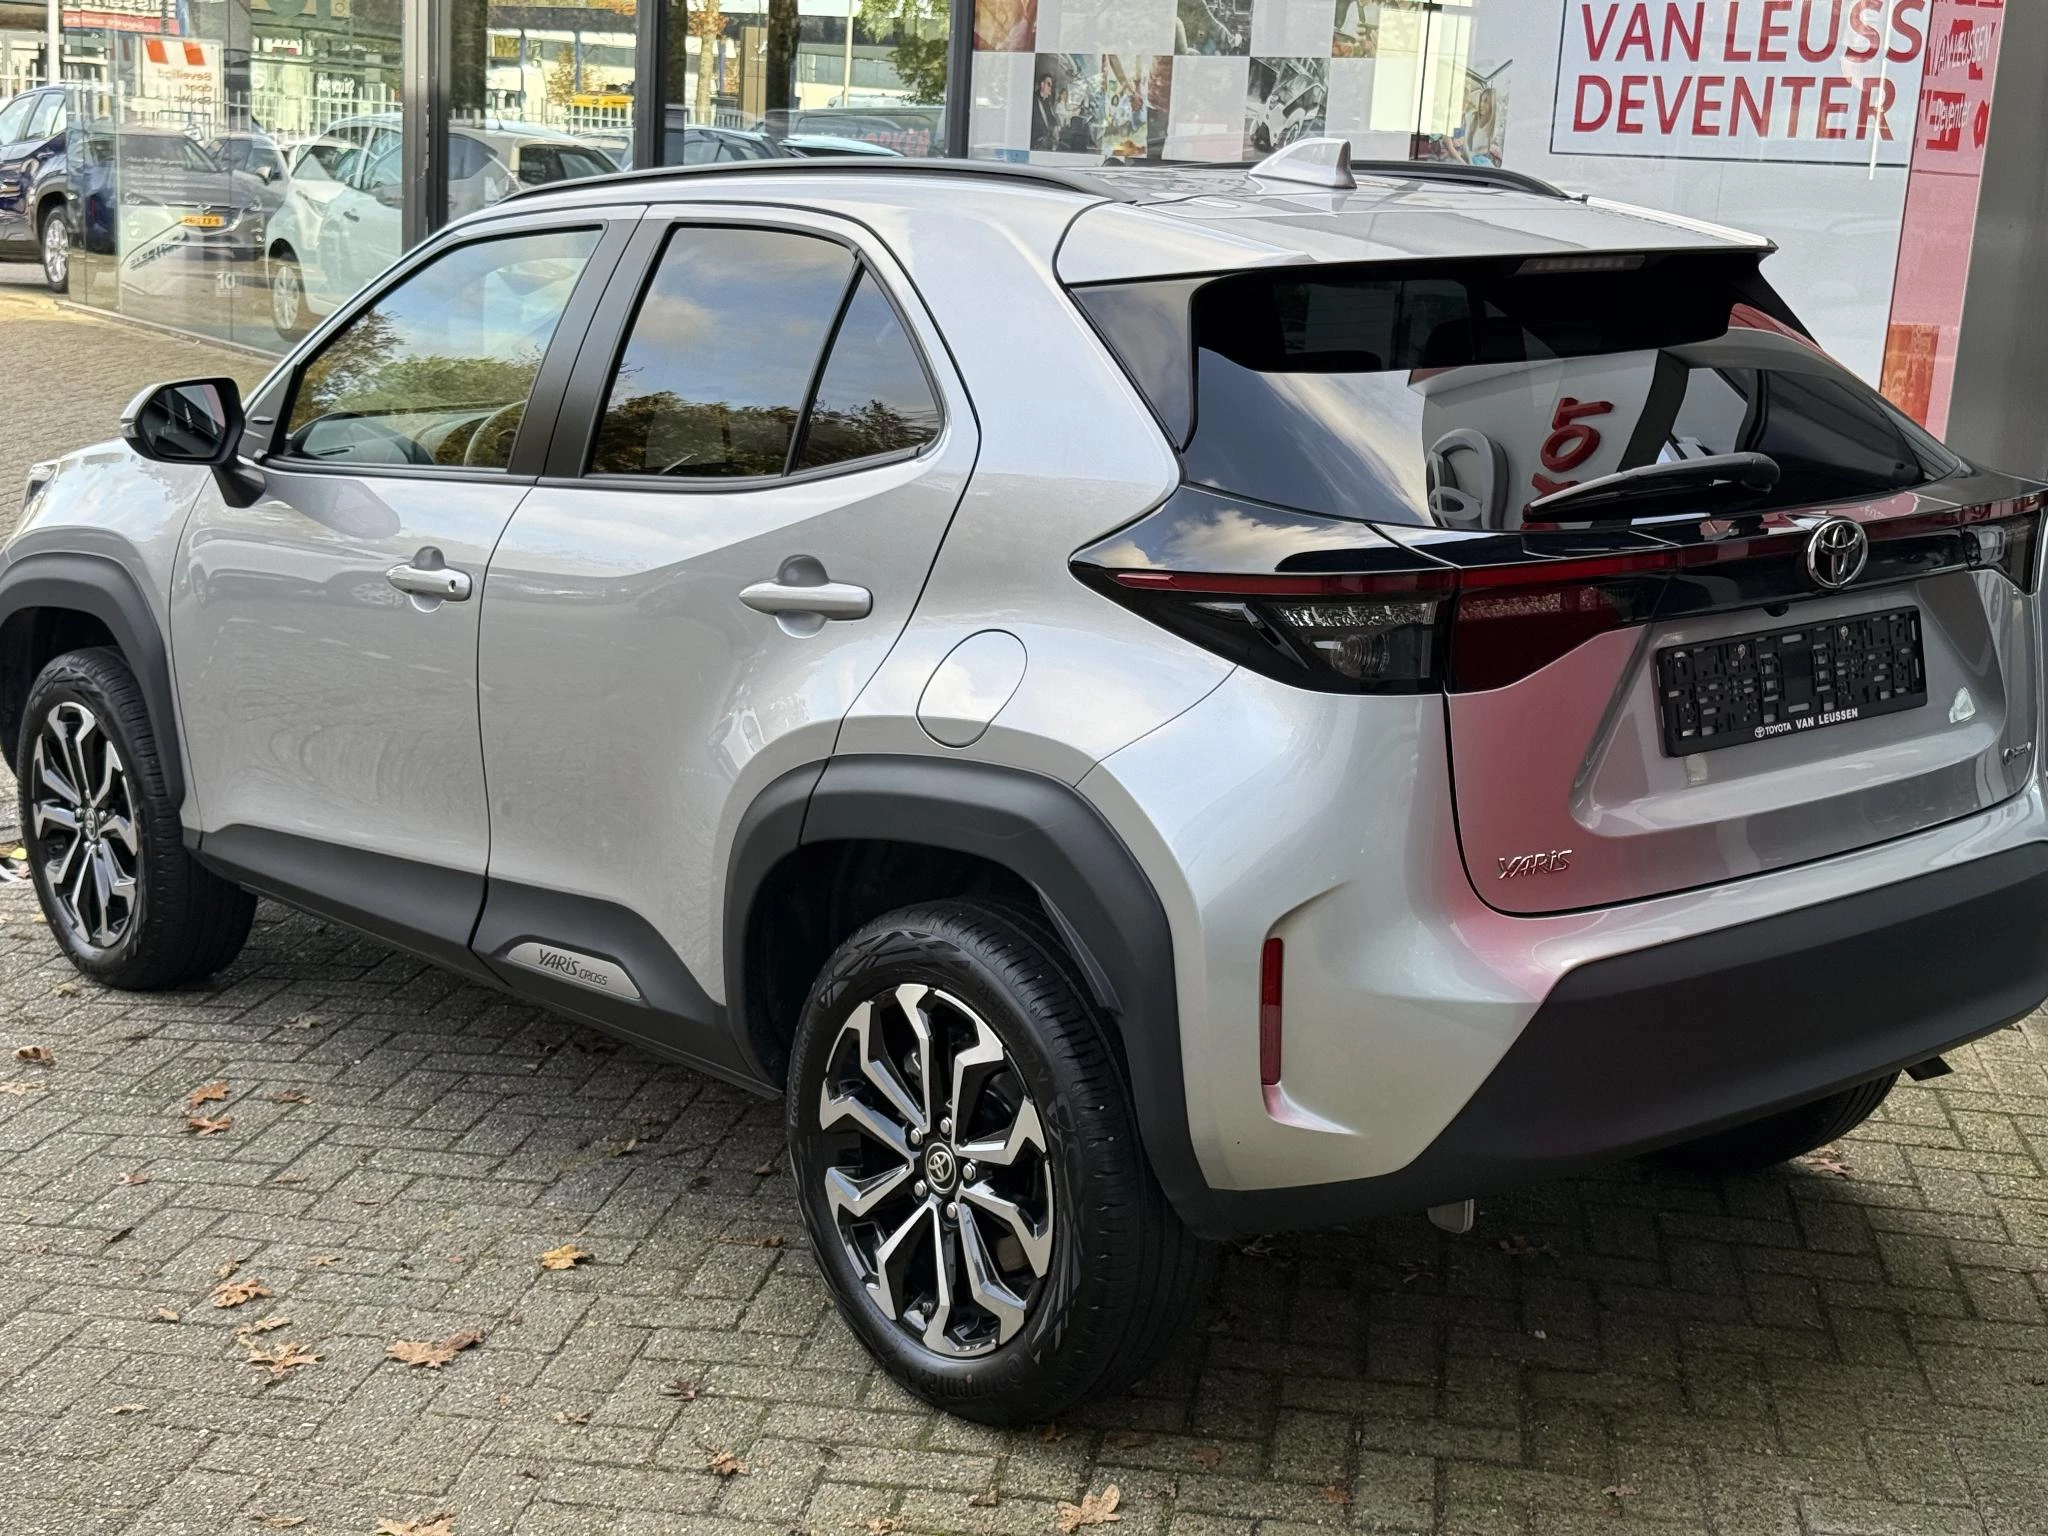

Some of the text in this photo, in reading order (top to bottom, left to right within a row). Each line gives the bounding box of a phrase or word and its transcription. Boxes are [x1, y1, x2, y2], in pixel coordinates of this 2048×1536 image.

[1582, 2, 1704, 62] VAN
[1573, 75, 1896, 141] DEVENTER
[1933, 97, 1972, 132] Deventer
[1765, 707, 1859, 736] TOYOTA VAN LEUSSEN
[578, 968, 608, 986] CROSS
